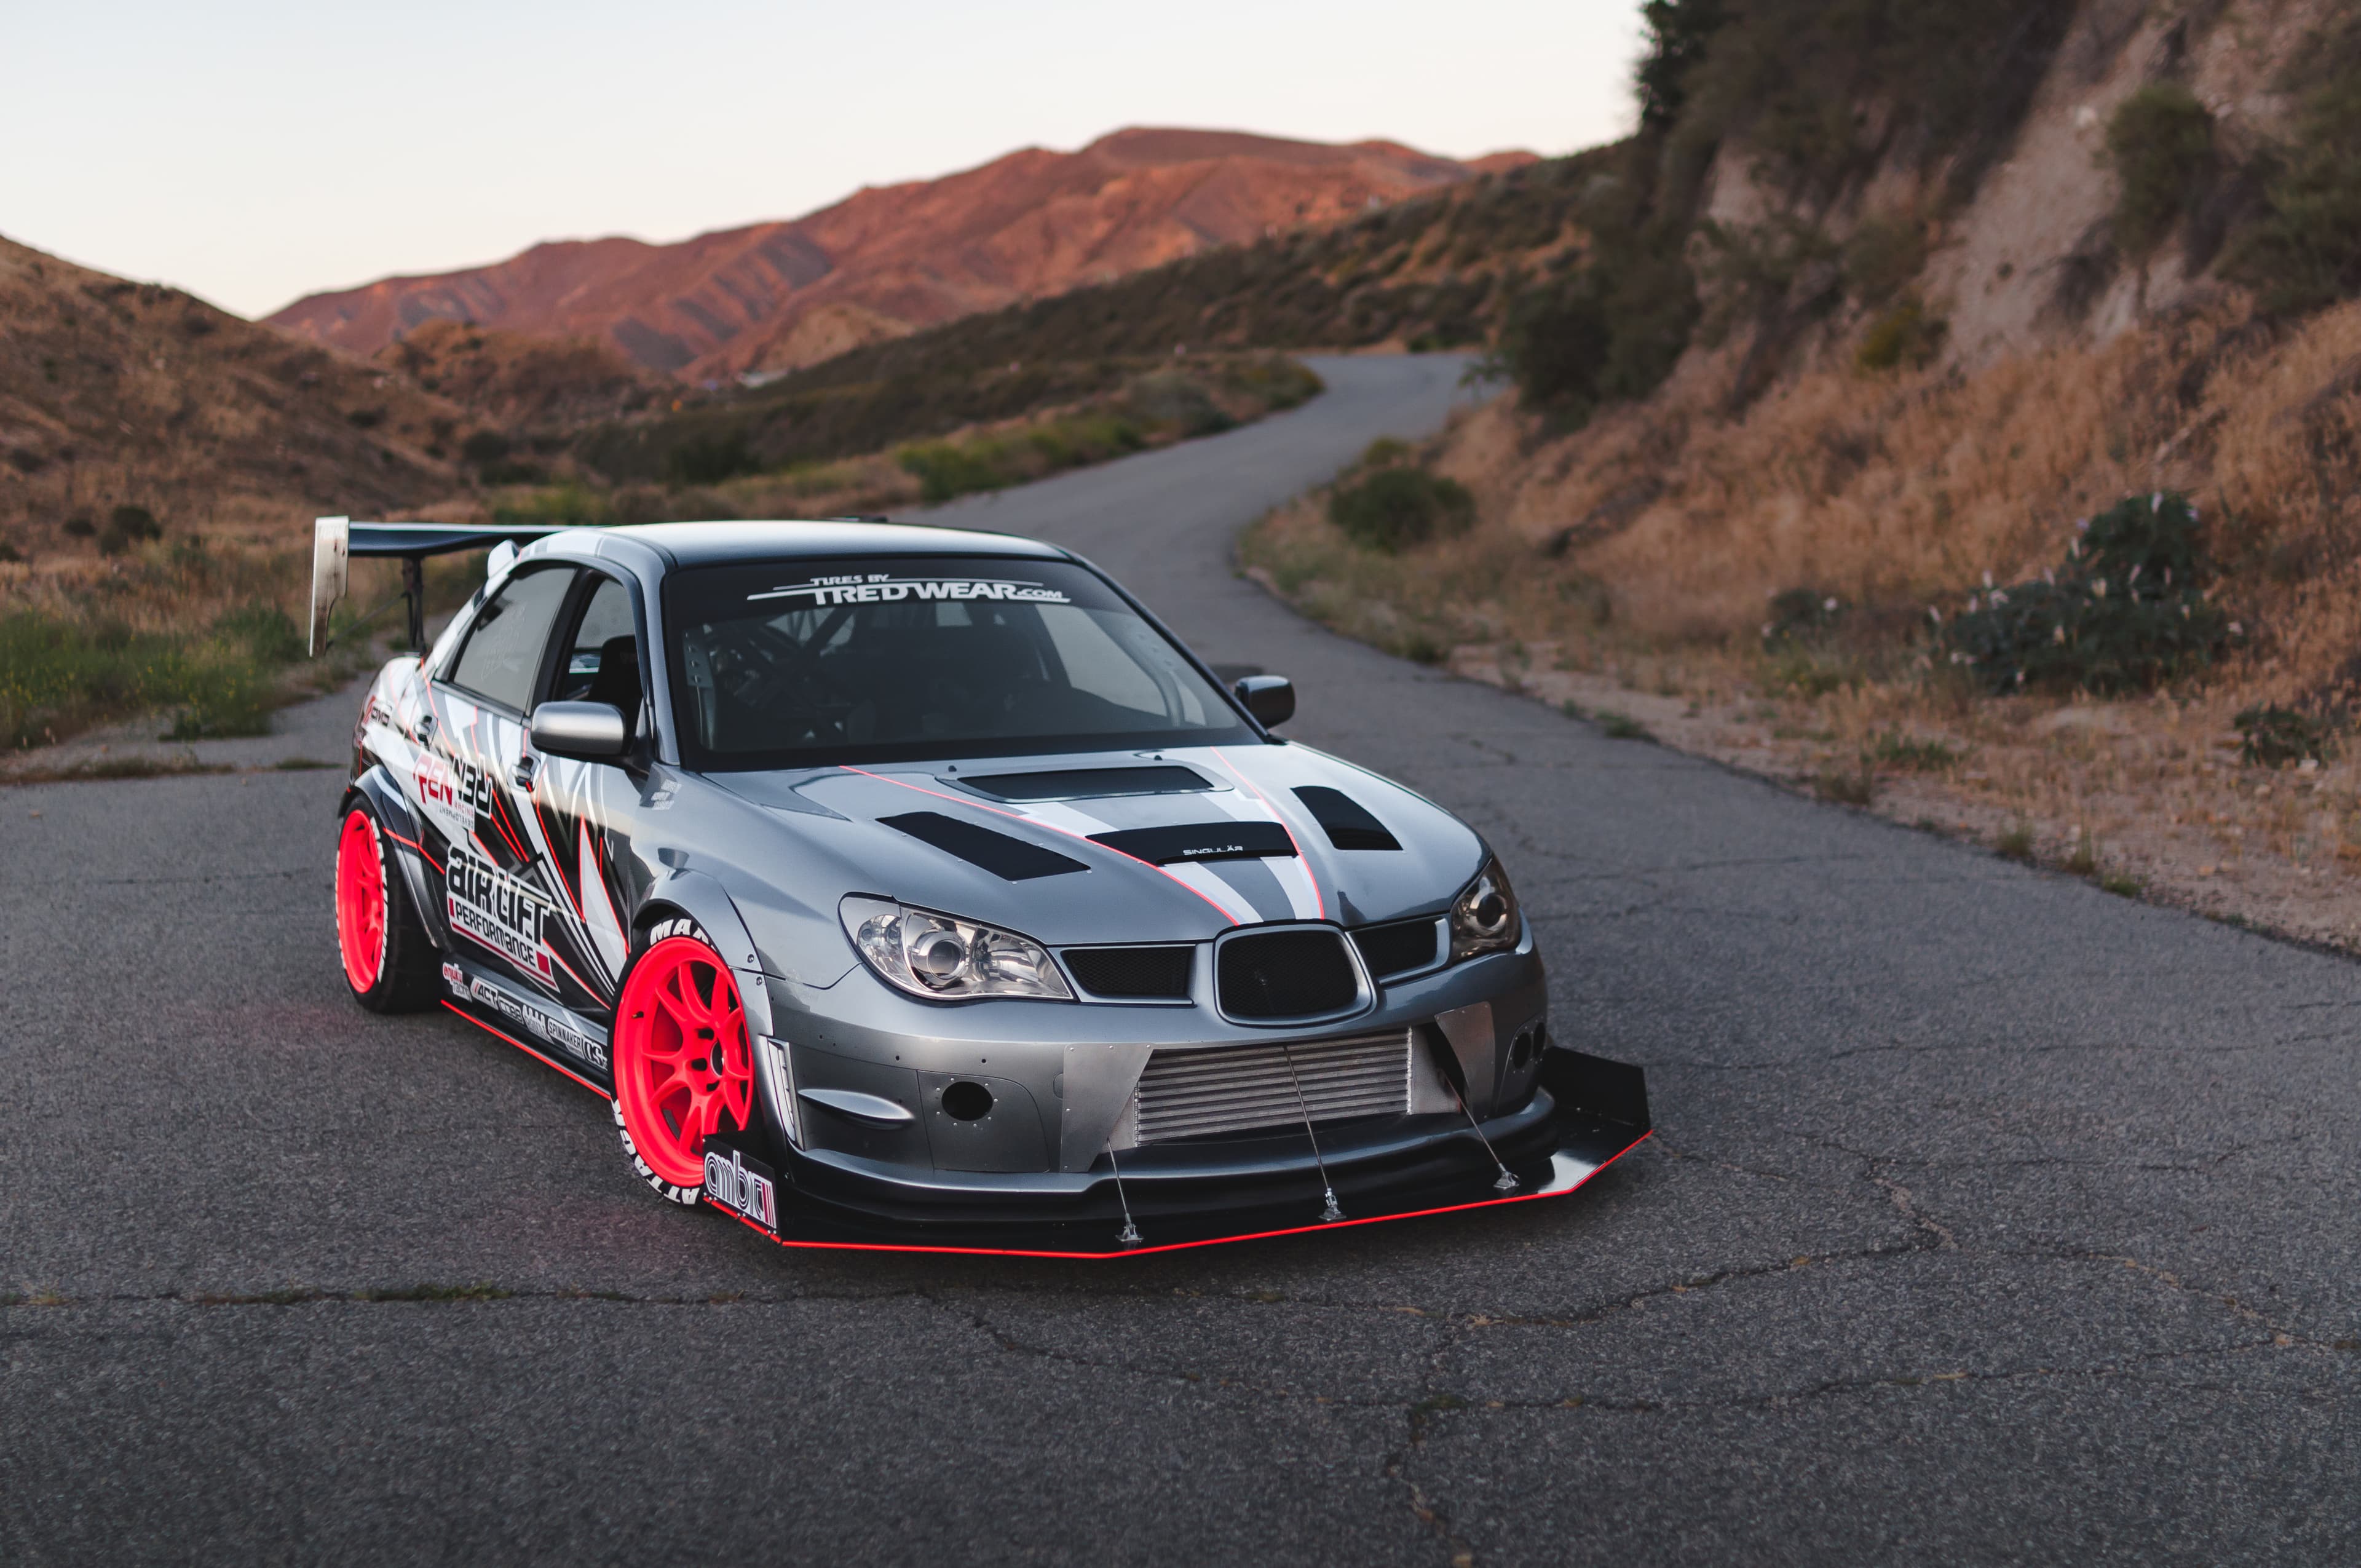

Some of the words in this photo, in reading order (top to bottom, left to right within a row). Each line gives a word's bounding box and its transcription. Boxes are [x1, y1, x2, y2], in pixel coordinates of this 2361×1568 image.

[810, 574, 863, 585] TIRES
[868, 574, 889, 583] BY
[439, 805, 474, 828] DEVELOPMENT
[454, 801, 474, 817] RACING
[477, 984, 498, 1004] ACT
[549, 1022, 582, 1050] SPINNAKER
[611, 1098, 700, 1205] ATTACK
